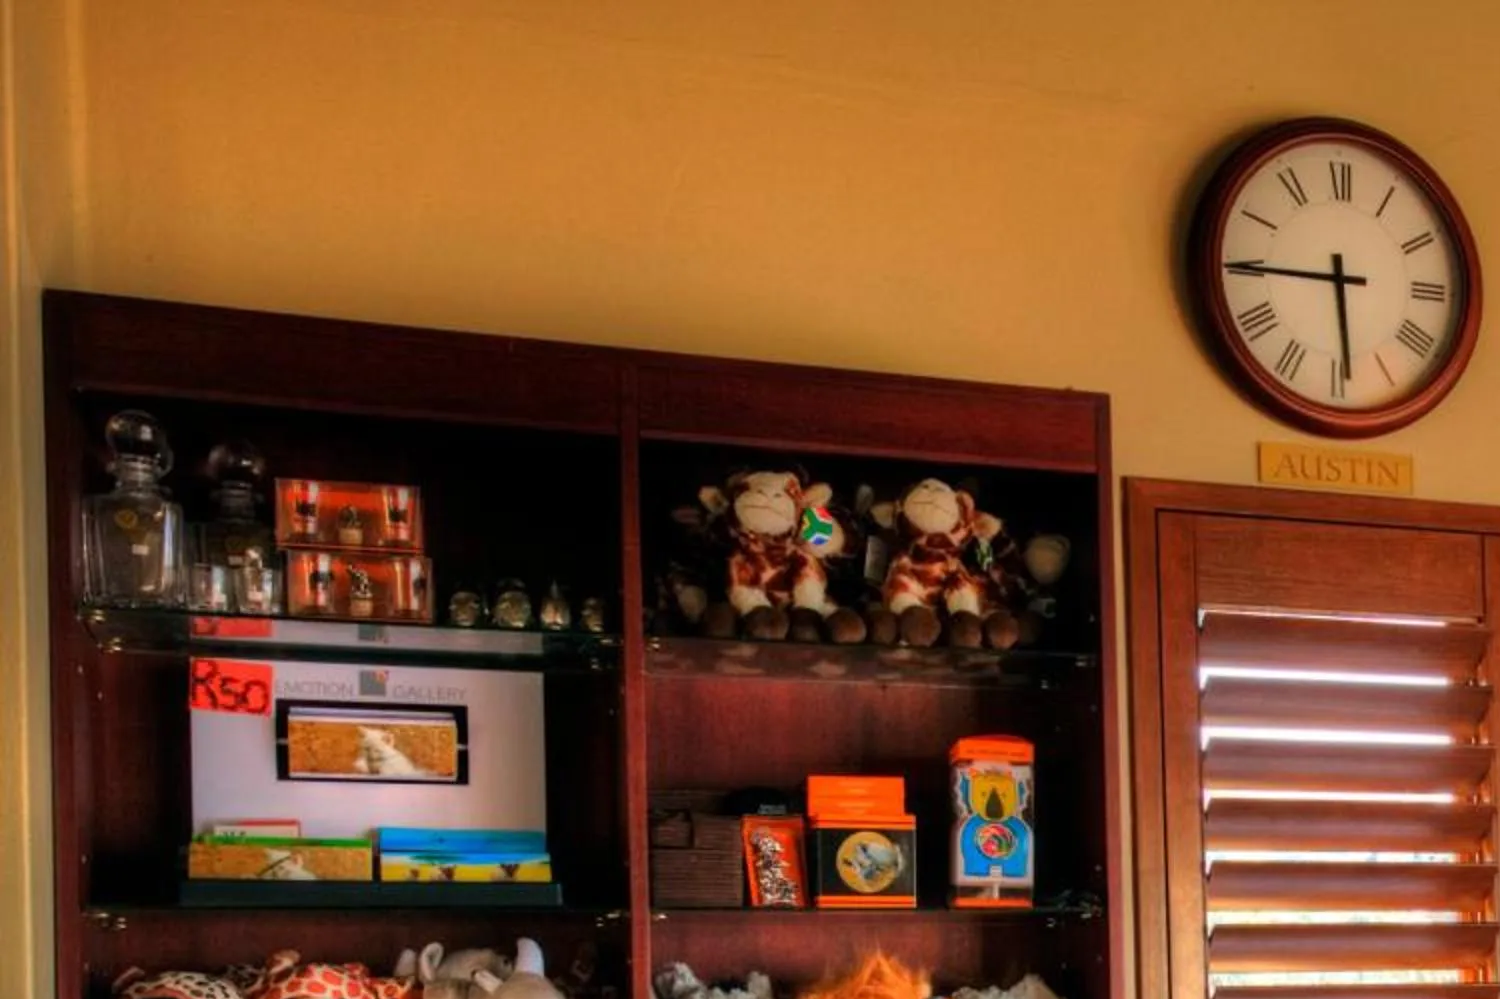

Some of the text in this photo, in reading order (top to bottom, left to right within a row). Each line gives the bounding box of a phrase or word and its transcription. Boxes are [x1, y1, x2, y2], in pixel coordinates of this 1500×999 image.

[1273, 453, 1399, 487] AUSTIN
[191, 659, 270, 714] R50
[392, 684, 468, 701] GALLERY
